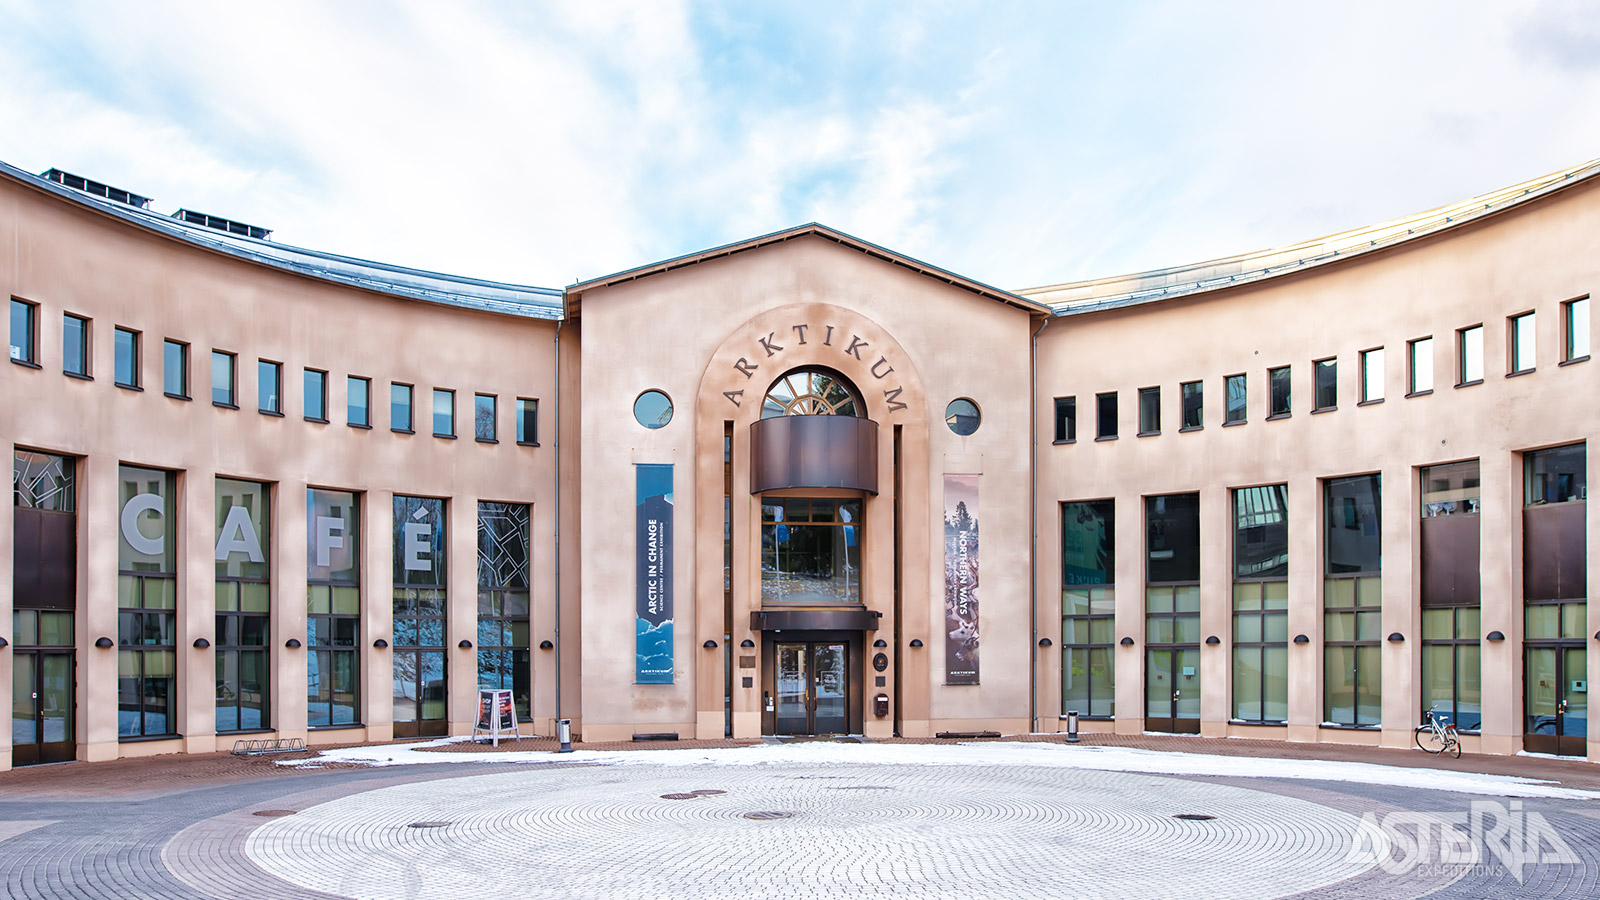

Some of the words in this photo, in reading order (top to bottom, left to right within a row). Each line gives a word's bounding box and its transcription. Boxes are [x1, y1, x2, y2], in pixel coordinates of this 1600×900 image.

[723, 324, 908, 414] ARKTIKUM
[121, 493, 432, 571] CAFÉ
[648, 519, 657, 562] CHANGE
[648, 565, 657, 577] IN
[959, 530, 967, 584] NORTHERN
[648, 580, 657, 615] ARCTIC
[959, 587, 967, 615] WAYS
